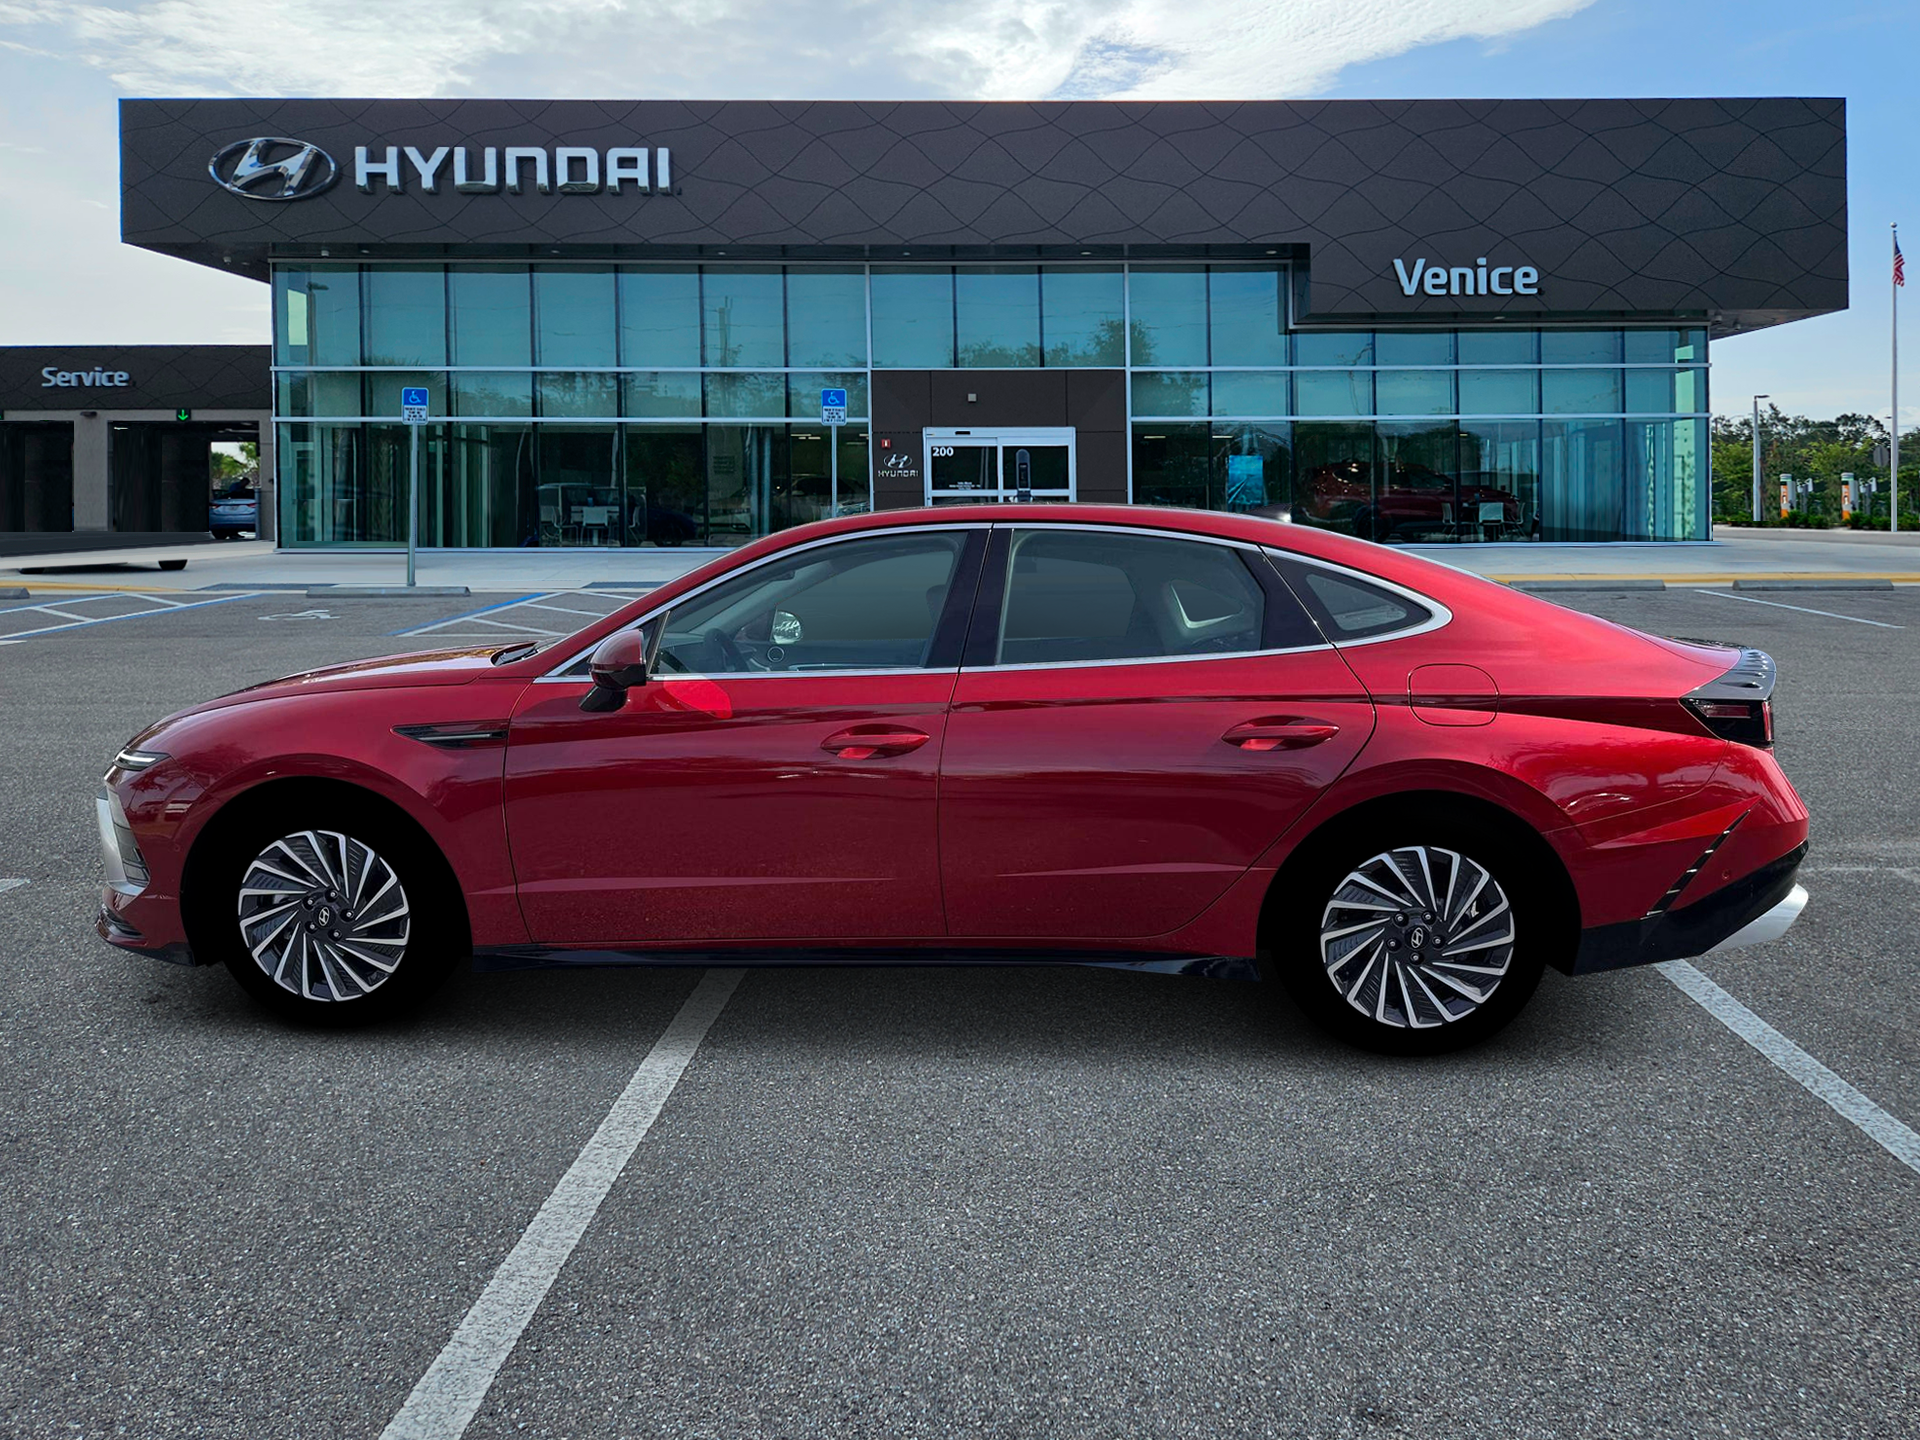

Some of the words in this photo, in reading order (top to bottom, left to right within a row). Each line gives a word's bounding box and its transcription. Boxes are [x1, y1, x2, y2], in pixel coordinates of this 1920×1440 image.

[354, 146, 672, 195] HYUNDAI
[1393, 257, 1539, 296] Venice
[41, 366, 130, 387] Service
[932, 446, 955, 457] 200
[877, 469, 919, 478] HYUNDAI
